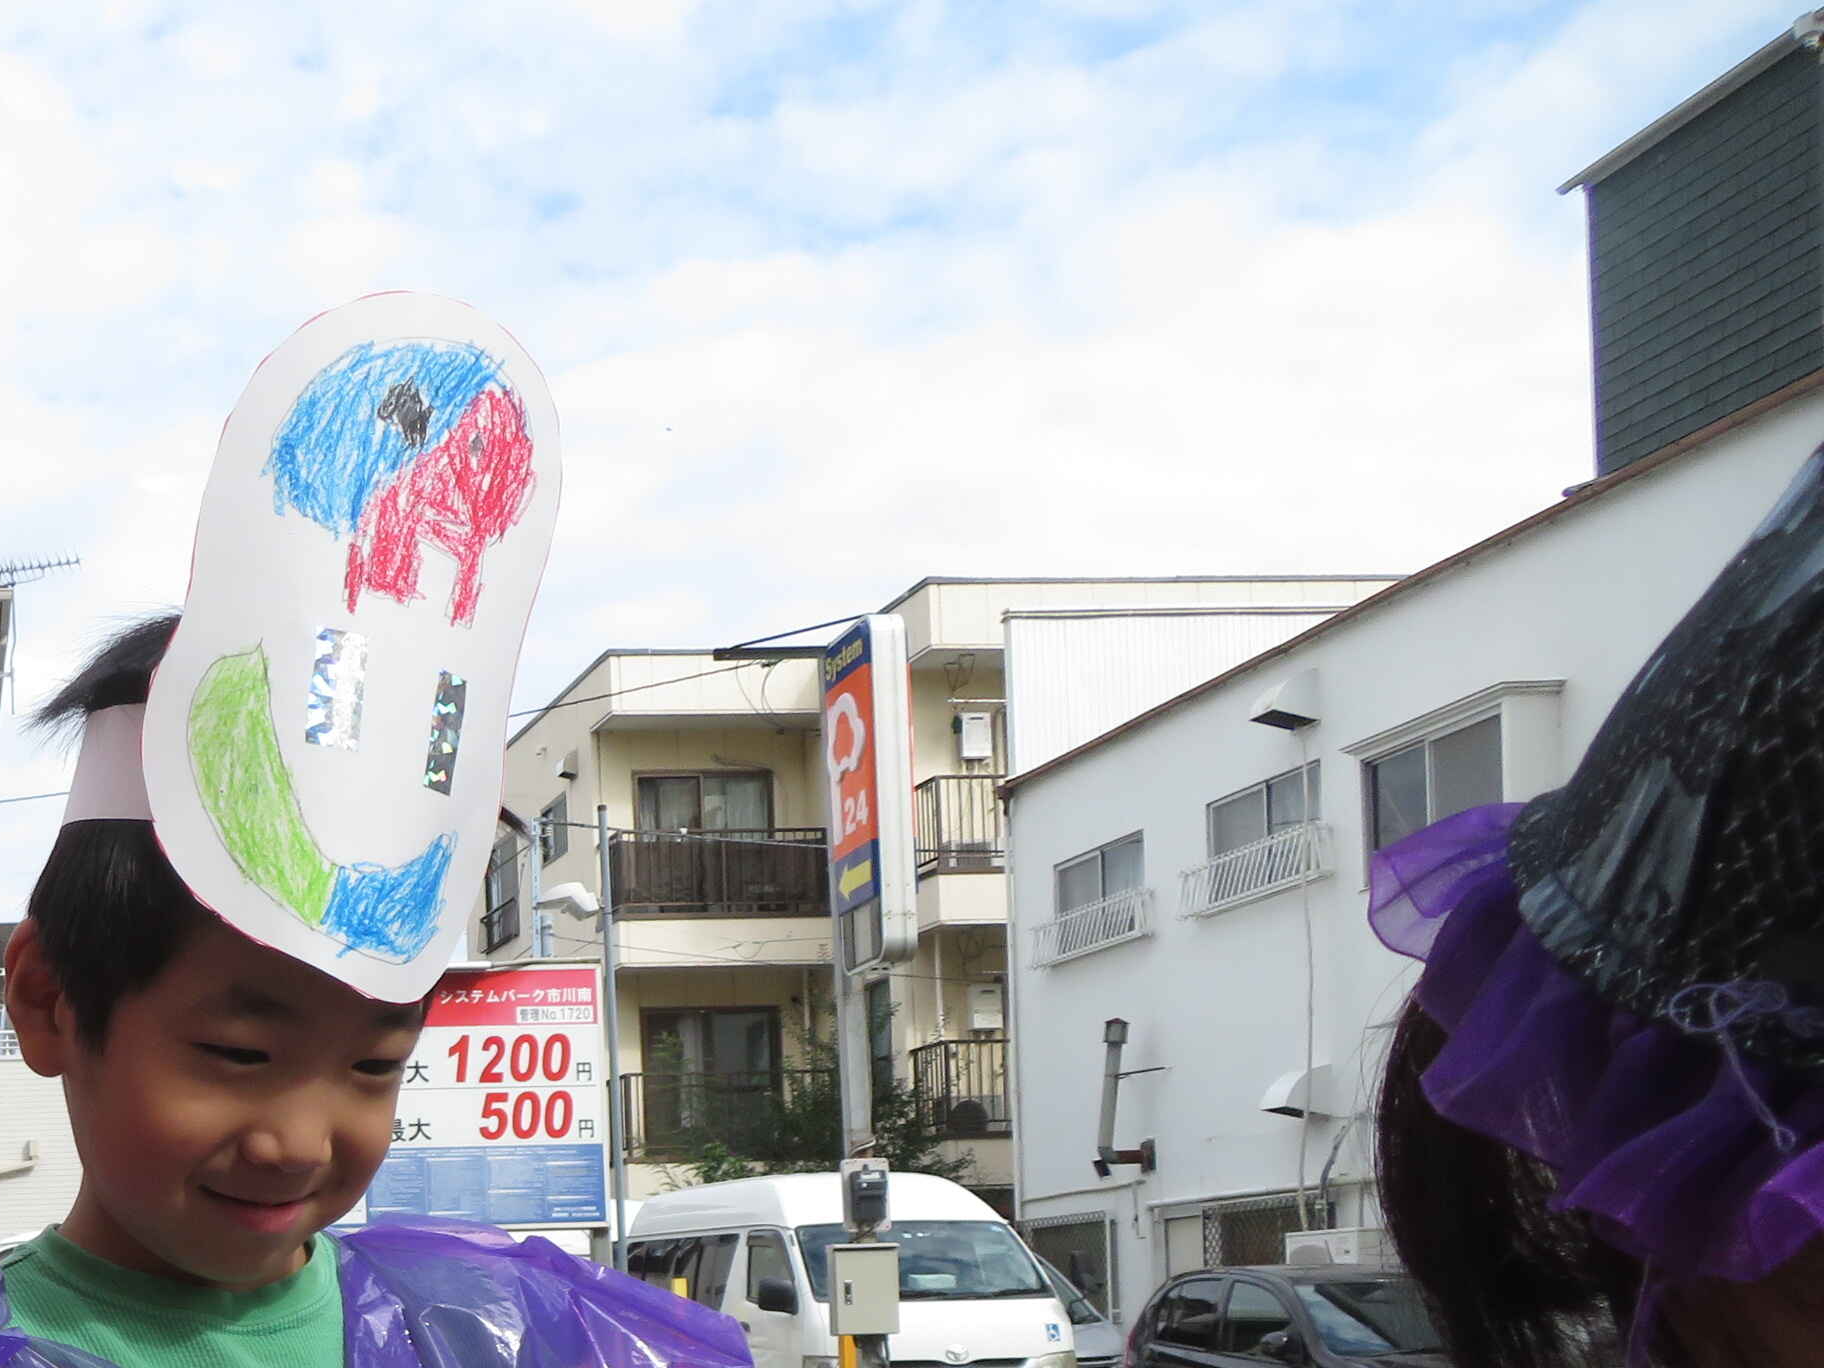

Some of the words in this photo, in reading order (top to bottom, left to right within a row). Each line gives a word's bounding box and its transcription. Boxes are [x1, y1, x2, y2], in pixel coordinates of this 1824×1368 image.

[826, 637, 863, 680] System
[844, 789, 869, 836] 24
[399, 1060, 430, 1084] 大
